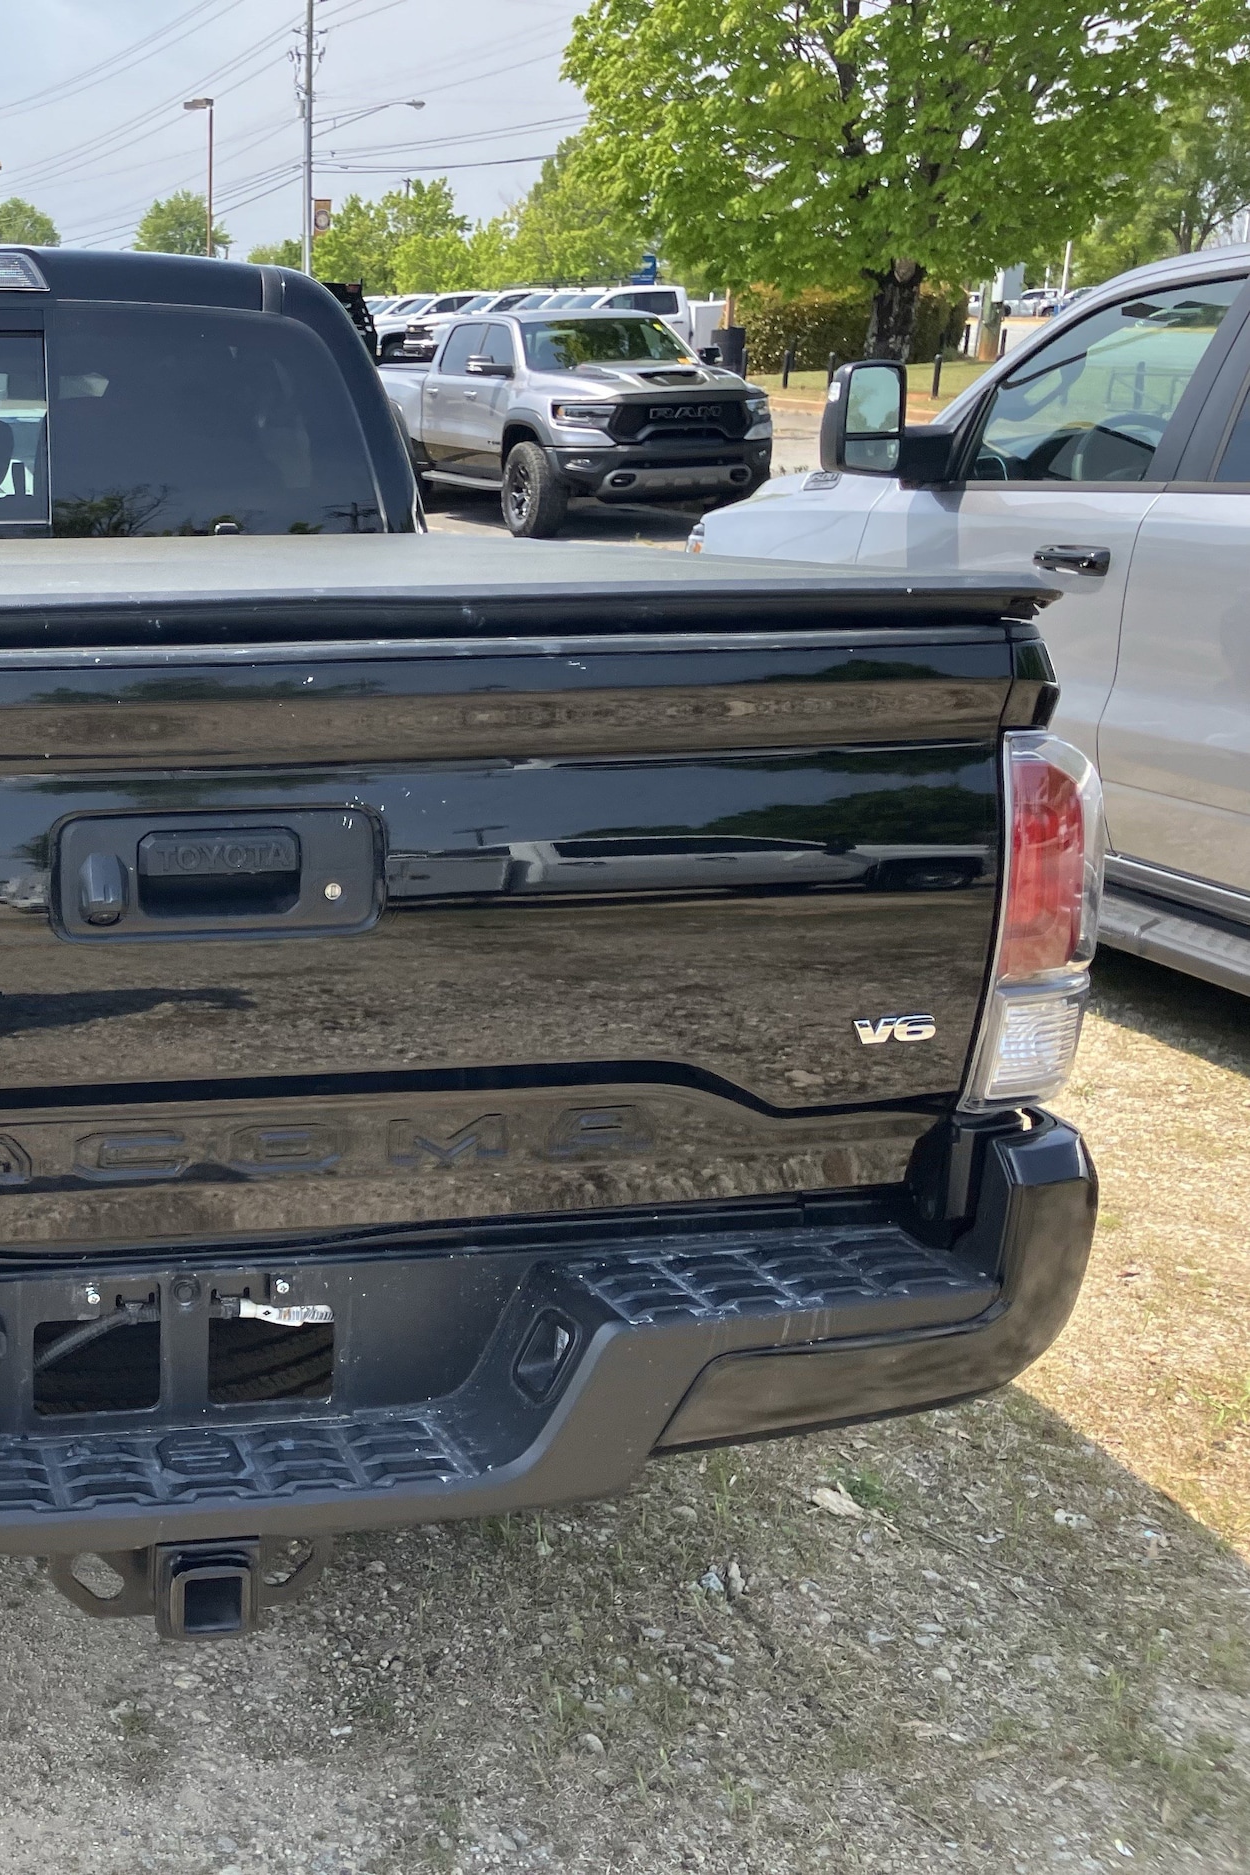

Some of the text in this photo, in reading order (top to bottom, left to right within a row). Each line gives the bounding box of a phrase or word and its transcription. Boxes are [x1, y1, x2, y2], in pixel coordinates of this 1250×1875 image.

[649, 405, 722, 419] RAM
[156, 841, 292, 872] TOYOTA
[853, 1014, 936, 1045] V6
